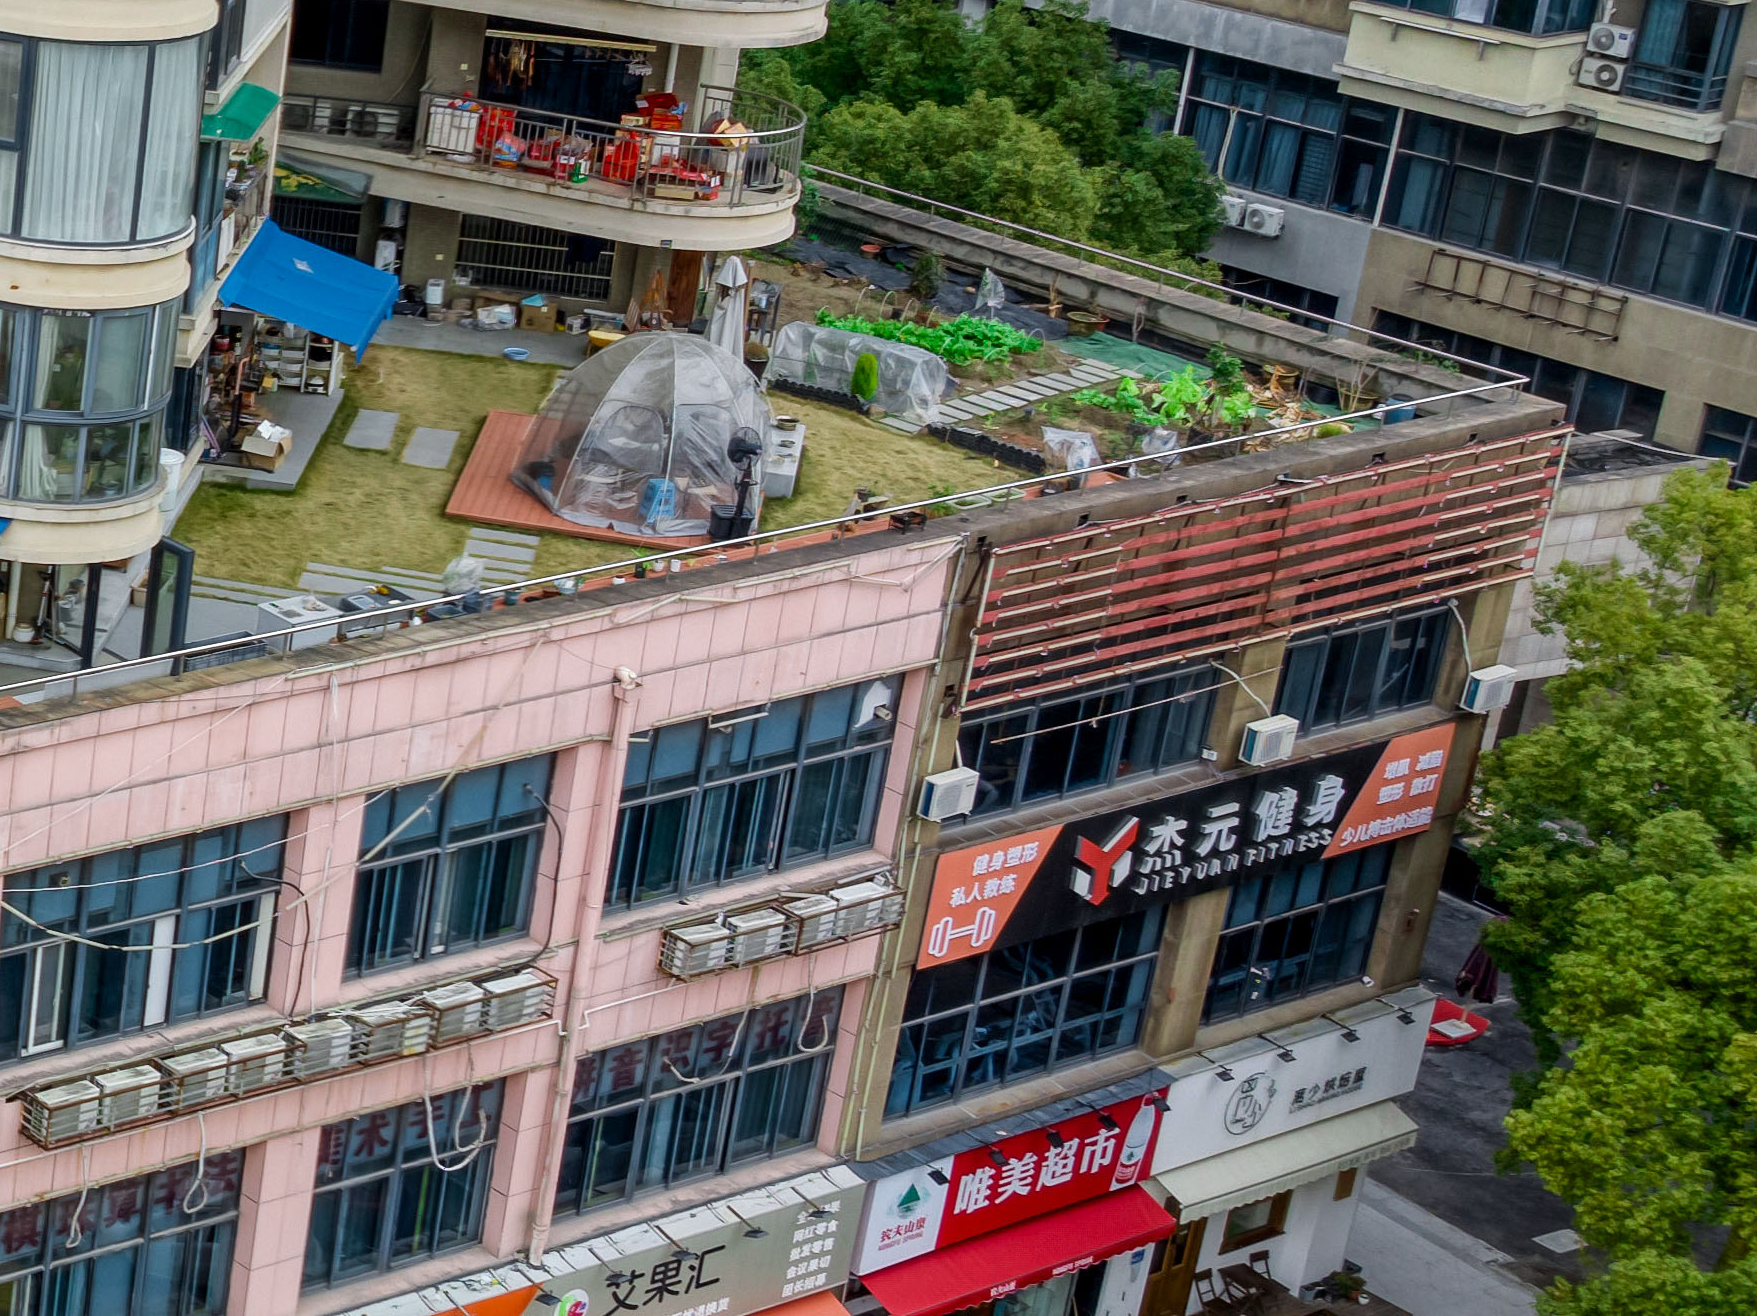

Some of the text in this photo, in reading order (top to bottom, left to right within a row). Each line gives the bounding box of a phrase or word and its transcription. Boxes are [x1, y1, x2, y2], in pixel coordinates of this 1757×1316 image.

[972, 841, 1040, 877] 健身塑形
[1137, 774, 1346, 875] 杰元健身
[949, 873, 1018, 908] 私人教练
[1131, 827, 1335, 897] JIEYUAN FITNESS
[953, 1127, 1121, 1215] 唯美超市
